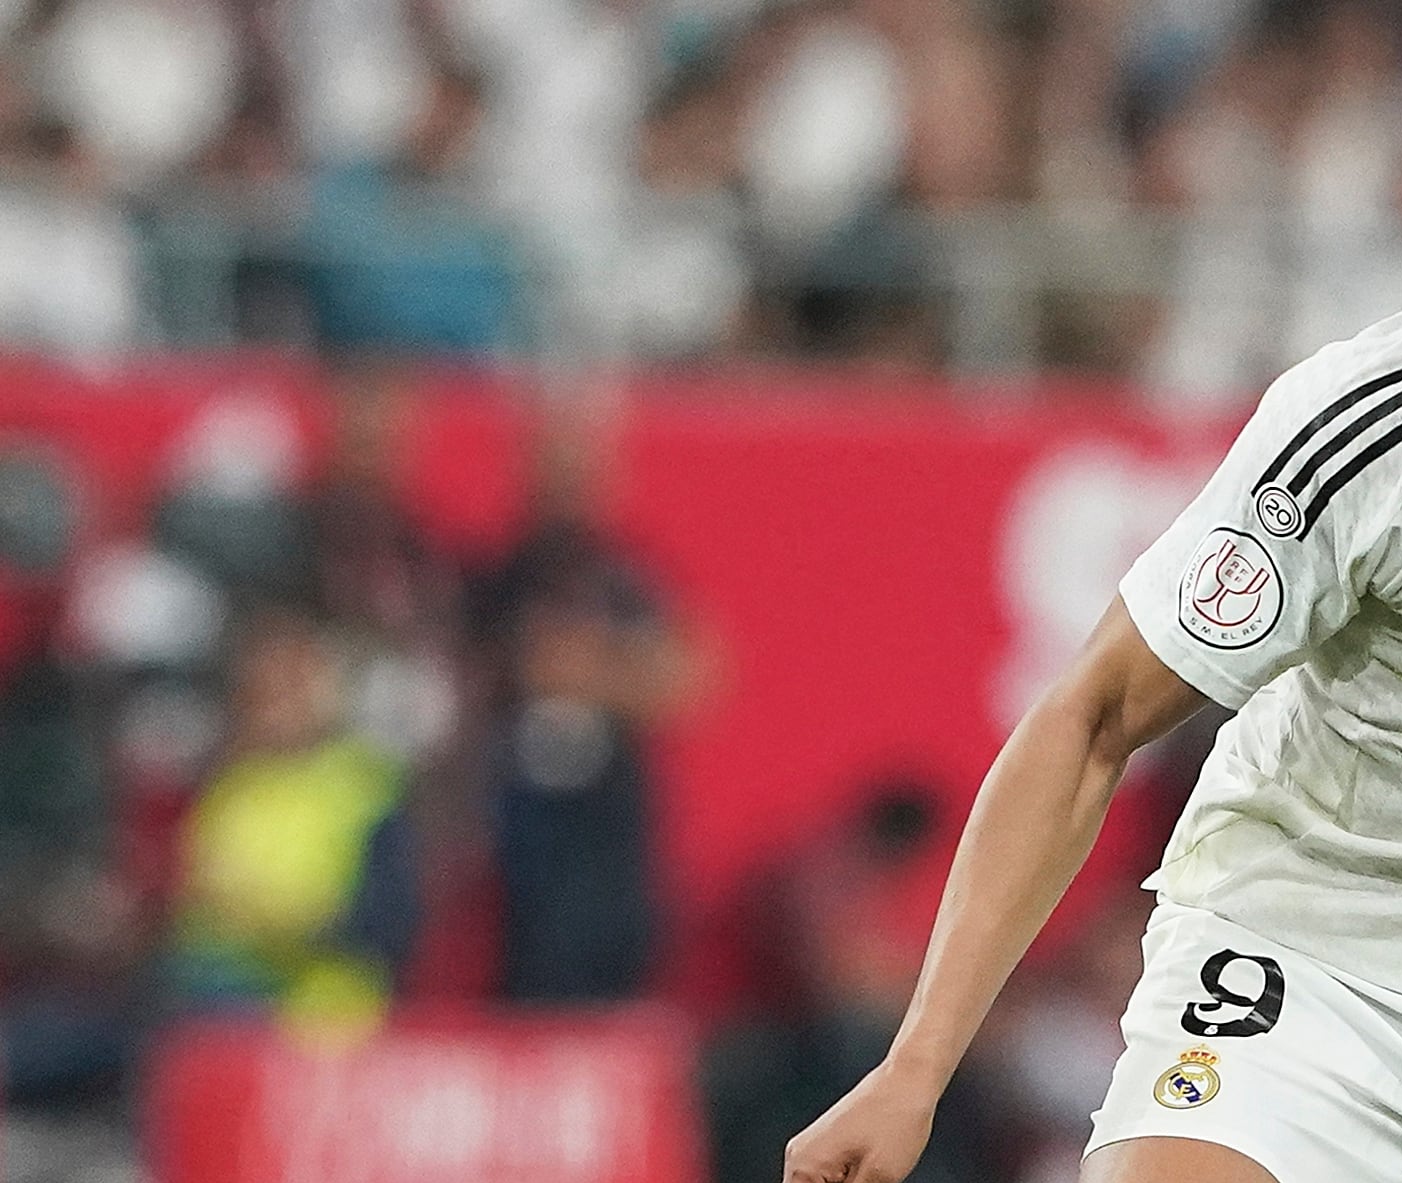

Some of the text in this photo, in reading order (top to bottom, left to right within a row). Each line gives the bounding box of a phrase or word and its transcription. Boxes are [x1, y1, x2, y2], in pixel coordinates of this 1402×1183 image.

[1265, 498, 1292, 526] 20
[1220, 632, 1238, 640] EL
[1242, 616, 1263, 636] REY
[1180, 948, 1286, 1037] 9
